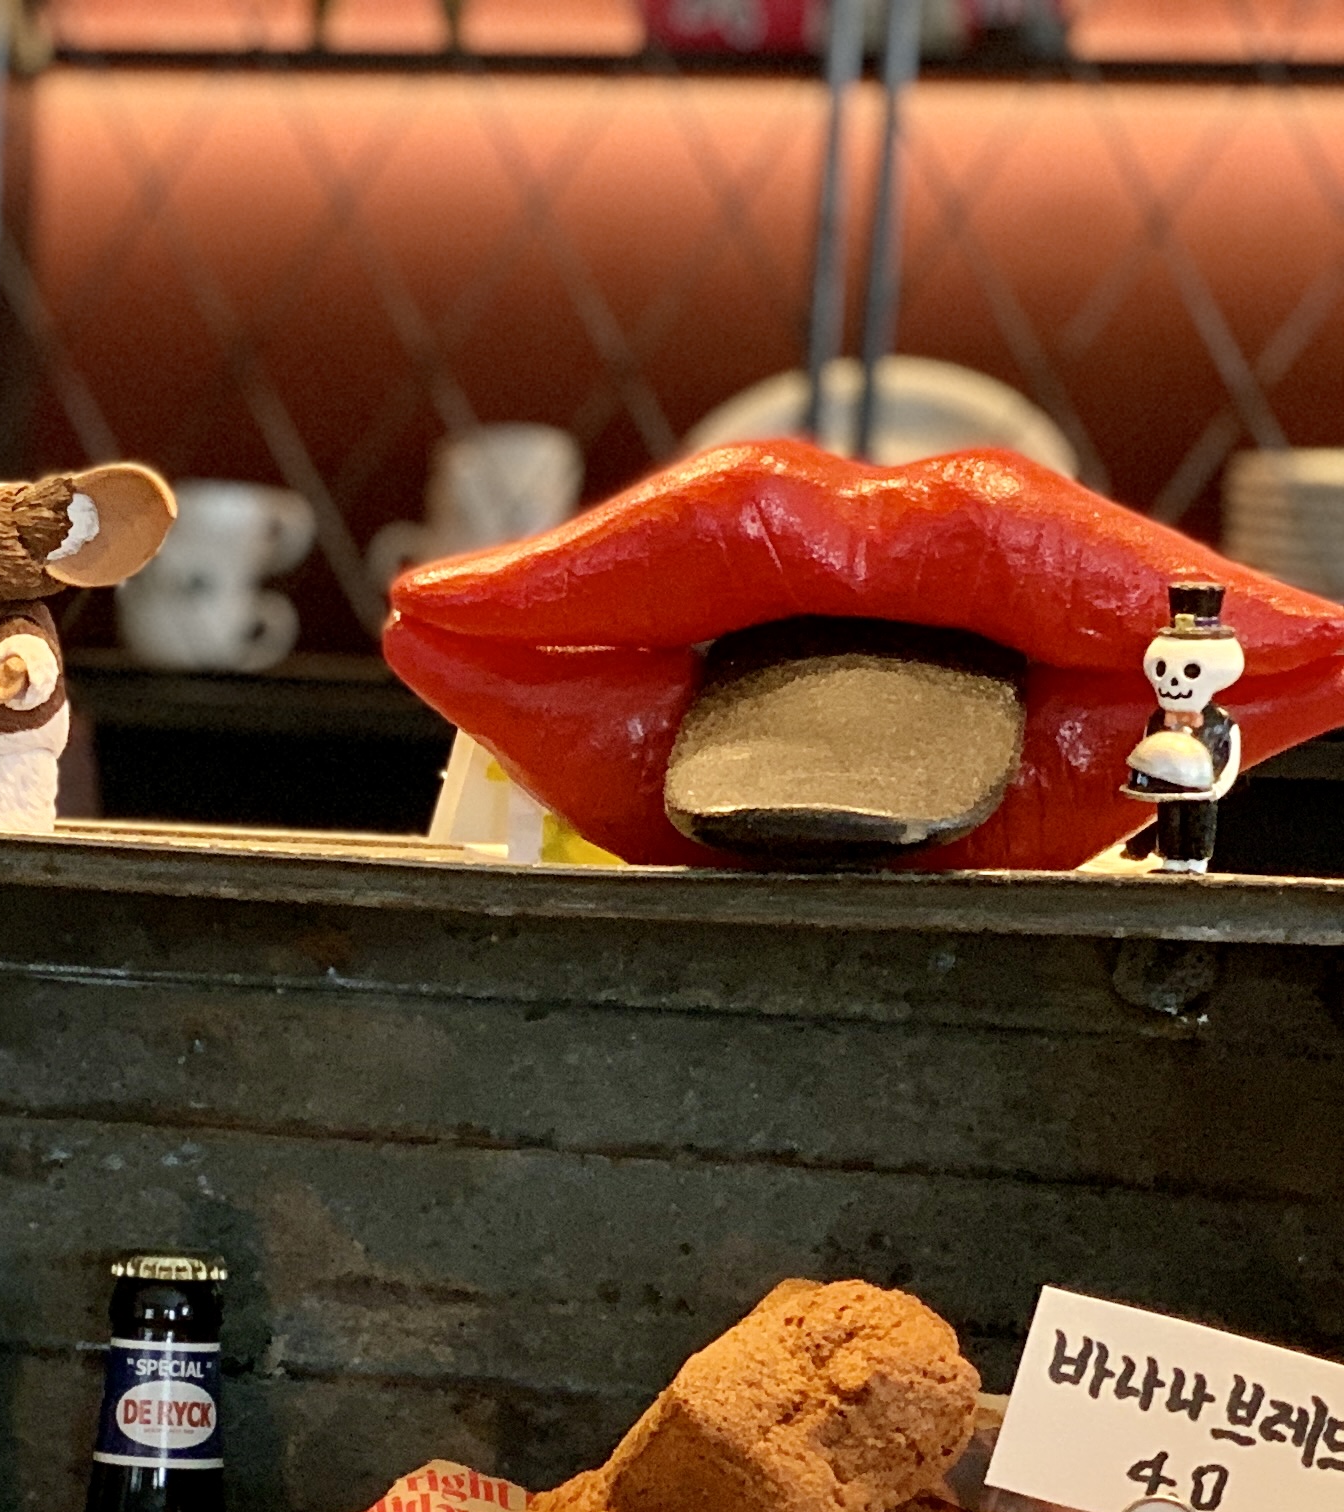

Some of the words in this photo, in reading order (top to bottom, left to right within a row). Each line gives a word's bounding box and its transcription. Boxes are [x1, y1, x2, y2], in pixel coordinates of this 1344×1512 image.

[123, 1398, 151, 1425] DE
[157, 1400, 212, 1429] RYCK
[406, 1469, 514, 1511] right
